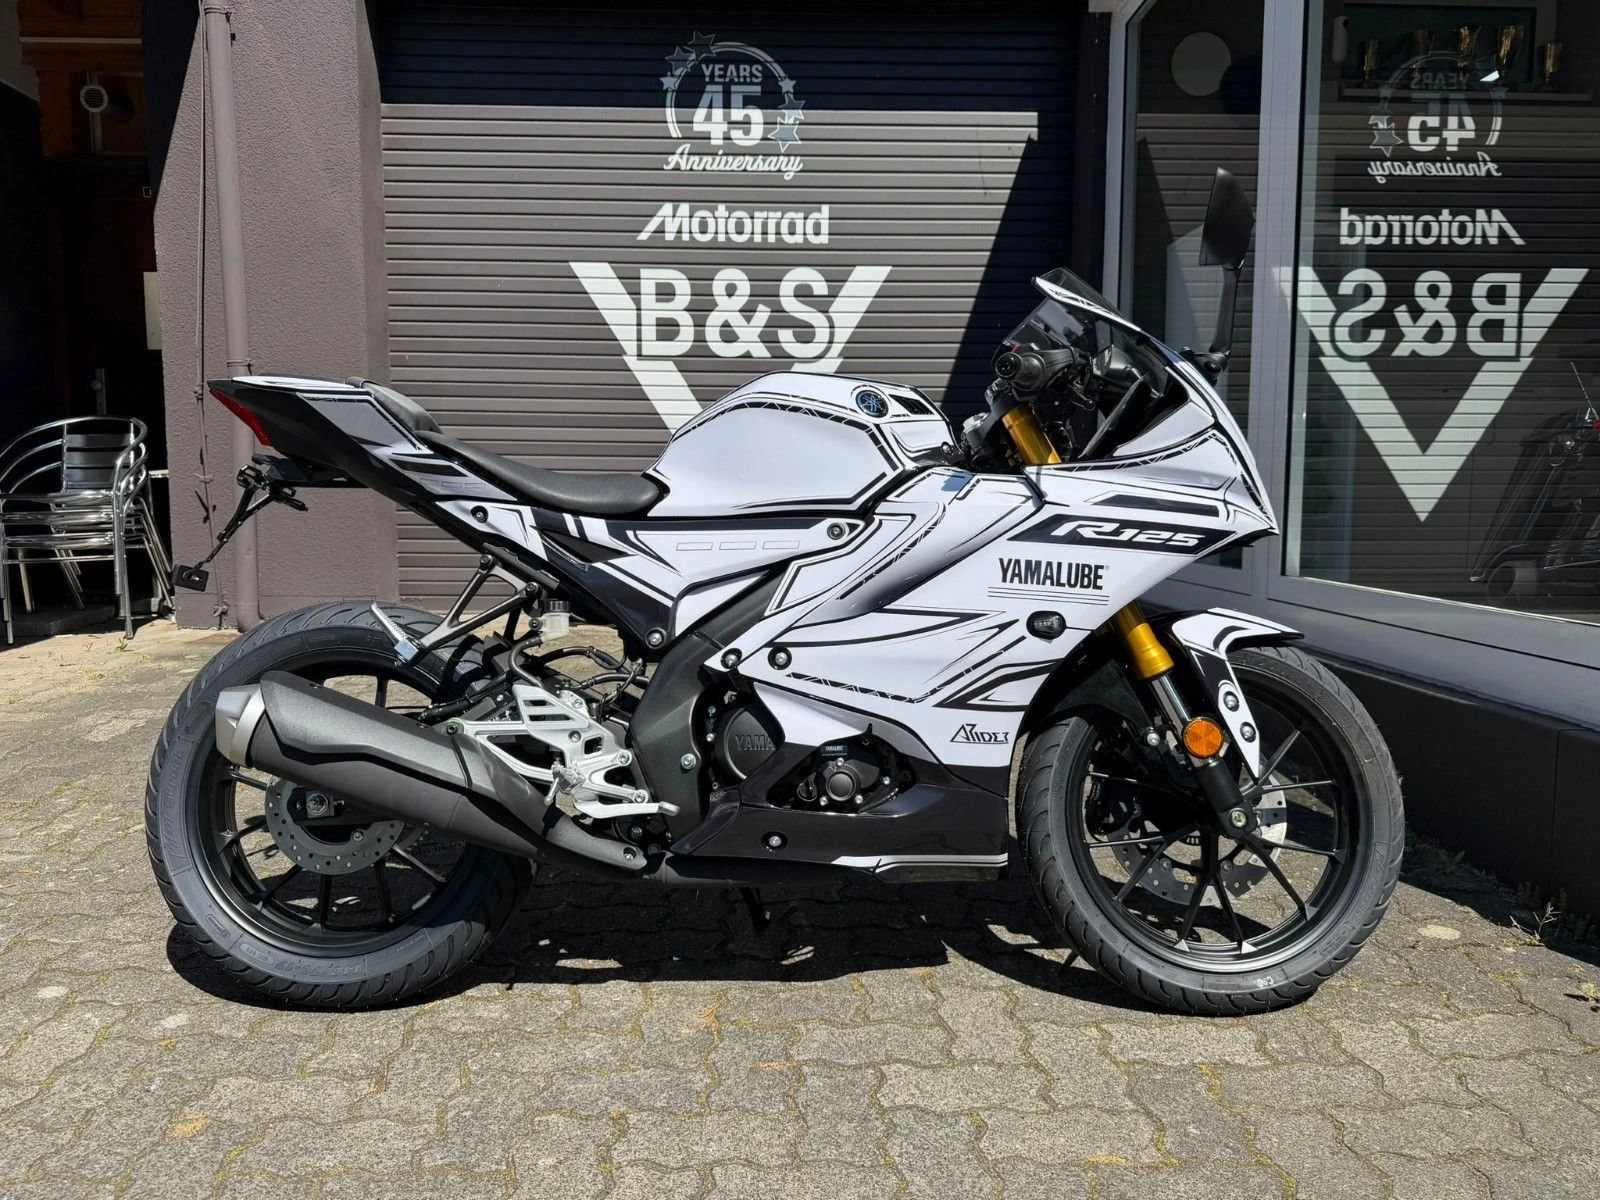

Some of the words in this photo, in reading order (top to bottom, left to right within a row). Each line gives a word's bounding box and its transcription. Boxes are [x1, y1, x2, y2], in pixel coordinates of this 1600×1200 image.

[701, 63, 763, 83] YEARS
[692, 84, 764, 147] 45
[663, 143, 804, 181] Anniversary
[636, 202, 830, 244] Motorrad
[640, 266, 831, 359] B&S
[998, 557, 1105, 591] YAMALUBE
